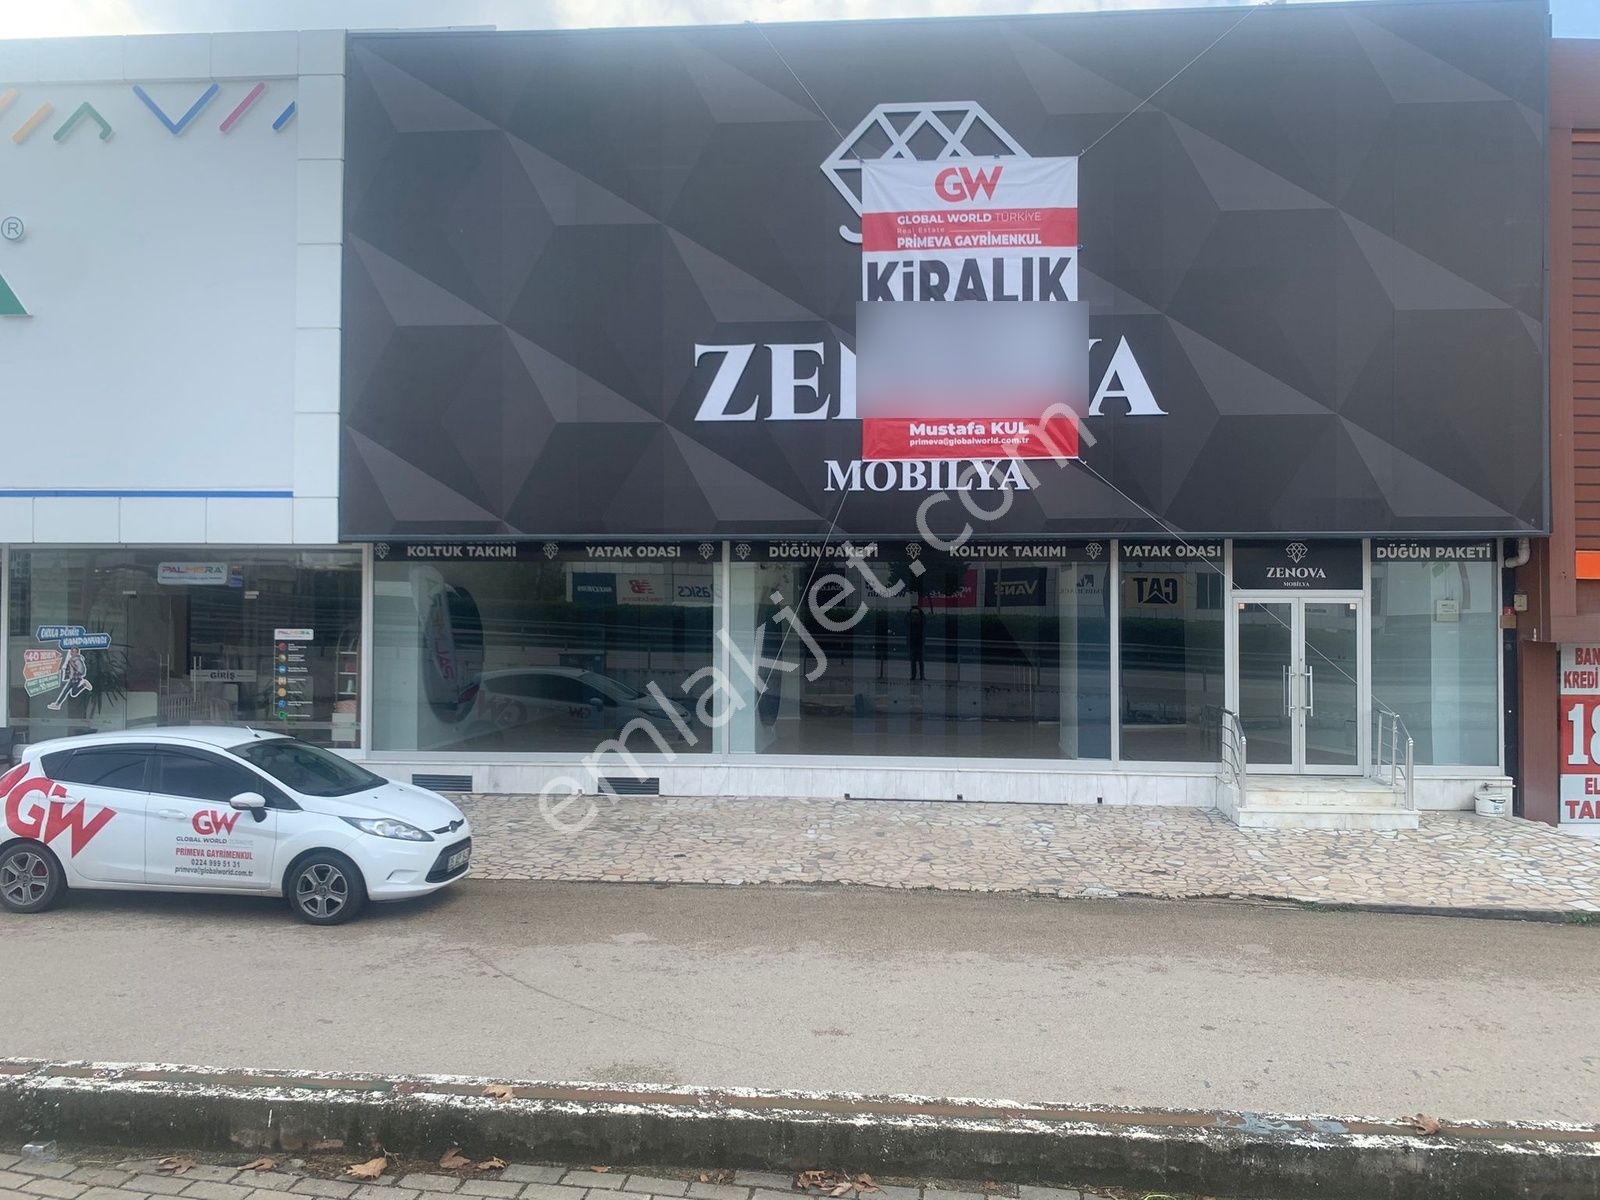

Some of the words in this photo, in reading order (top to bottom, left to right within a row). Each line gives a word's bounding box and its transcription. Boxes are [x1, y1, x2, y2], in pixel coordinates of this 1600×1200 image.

[935, 166, 1003, 202] GW
[897, 214, 944, 225] GLOBAL
[947, 212, 991, 223] WORLD
[995, 211, 1041, 222] TÜRKİYE
[897, 234, 952, 248] PRİMEVA
[955, 232, 1042, 246] GAYRİMENKUL
[909, 422, 985, 436] Mustafa
[991, 422, 1029, 434] KUL
[909, 437, 1030, 446] primeva@globalworld.com.tr
[407, 545, 463, 557] KOLTUK
[466, 545, 517, 557] TAKIMI
[586, 546, 633, 557] YATAK
[637, 546, 681, 557] ODASI
[769, 543, 820, 557] DÜĞÜN
[949, 545, 1008, 557] KOLTUK
[1013, 545, 1066, 557] TAKIMI
[1123, 545, 1171, 557] YATAK
[1175, 545, 1221, 557] ODASI
[1376, 543, 1431, 558] DÜĞÜN
[1435, 543, 1491, 558] PAKETİ
[1266, 567, 1327, 578] ZENOVA
[1563, 666, 1598, 688] KREDİ
[192, 810, 242, 835] GW
